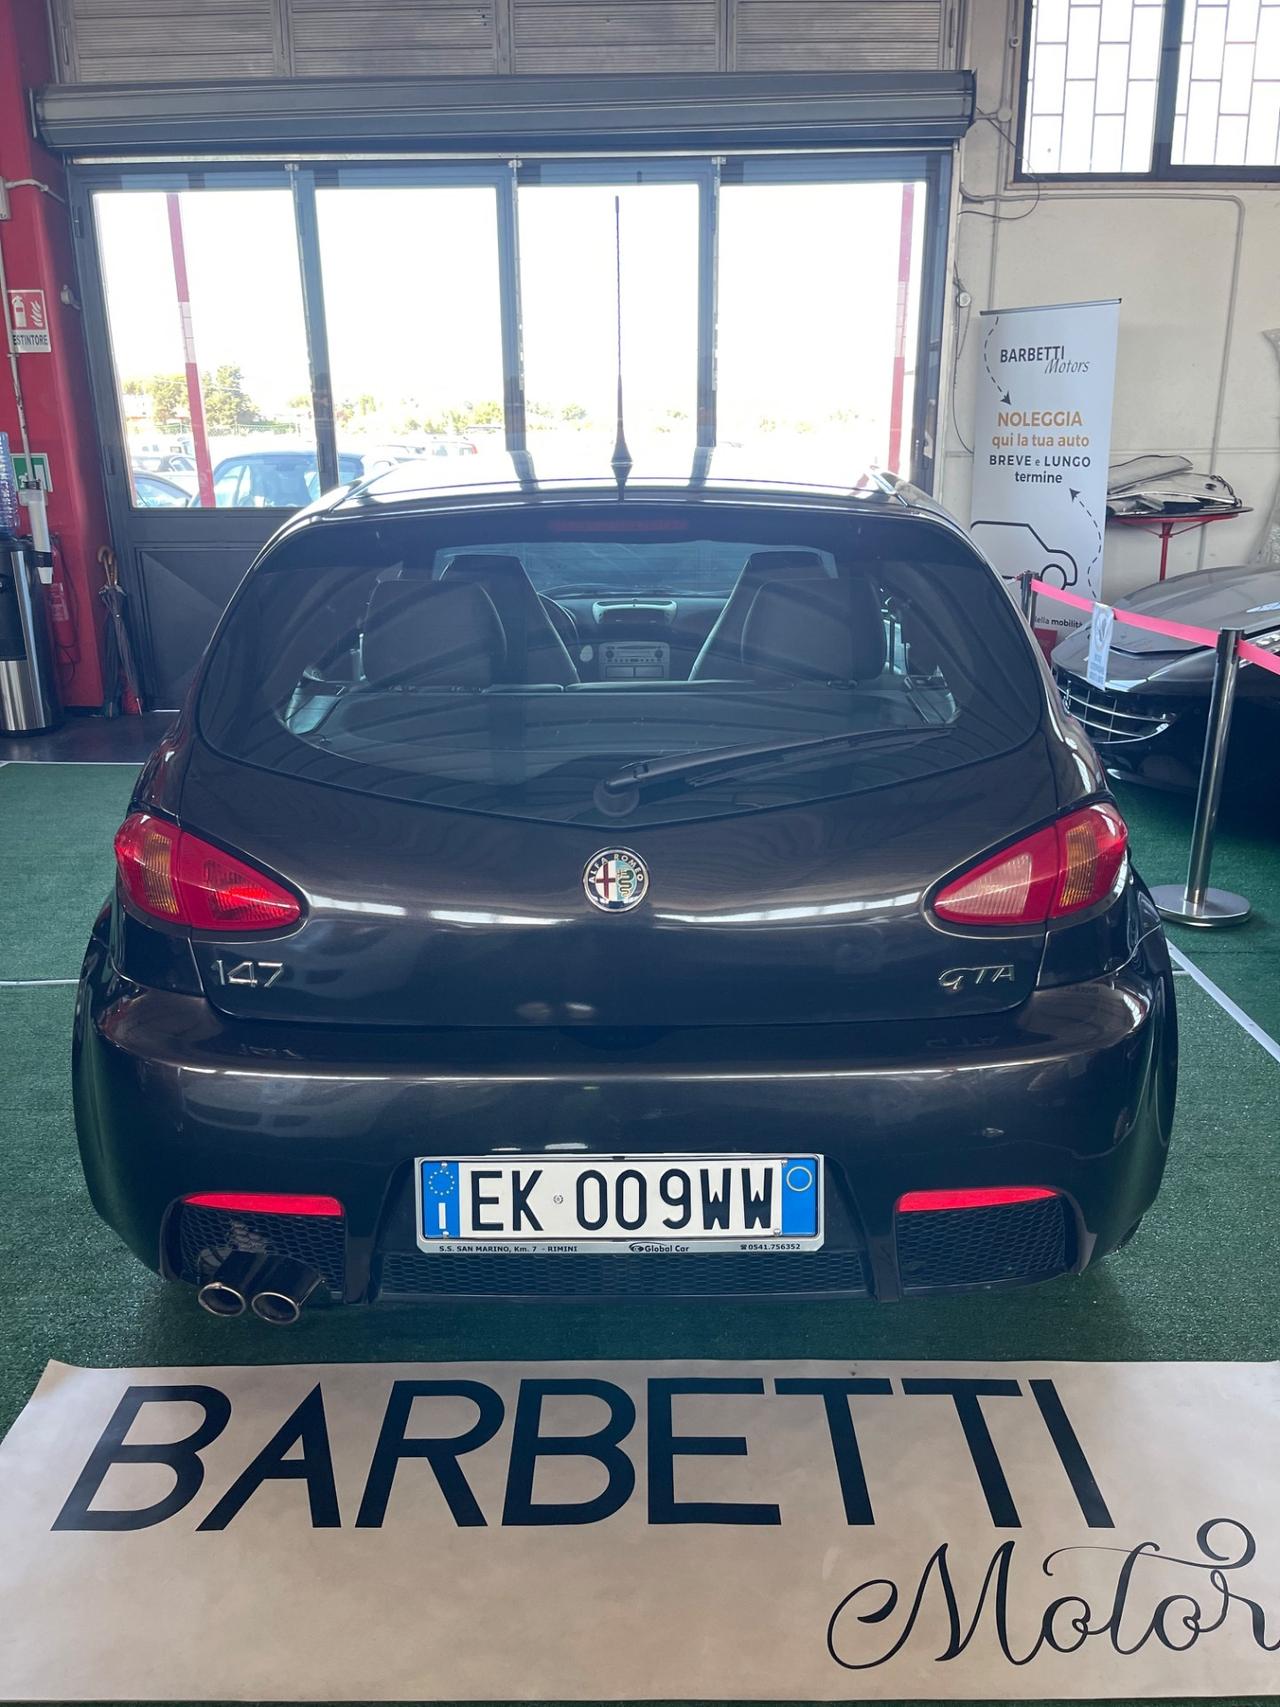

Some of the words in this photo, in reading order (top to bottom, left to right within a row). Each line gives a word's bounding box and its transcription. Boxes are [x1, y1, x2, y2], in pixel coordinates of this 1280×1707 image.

[12, 334, 49, 346] ESTINTORE
[1000, 345, 1065, 364] BARBETTI
[1045, 358, 1091, 375] Motors
[997, 411, 1083, 427] NOLEGGIA
[991, 433, 1014, 449] qui
[1017, 433, 1029, 447] la
[1032, 434, 1054, 447] tua
[1058, 435, 1090, 447] auto
[989, 455, 1032, 466] BREVE
[1034, 458, 1041, 466] e
[1044, 456, 1091, 468] LUNGO
[1015, 471, 1063, 484] termine
[588, 857, 608, 884] ALFA
[613, 853, 644, 882] ROMEO
[211, 959, 284, 988] 147
[938, 965, 1015, 990] GTA
[471, 1169, 544, 1231] EK
[576, 1167, 773, 1231] 009WW
[439, 1245, 454, 1253] S.S.
[457, 1245, 473, 1253] SAN
[476, 1245, 512, 1254] MARINO,
[514, 1245, 530, 1253] Km.
[532, 1245, 537, 1253] 7
[548, 1245, 577, 1253] RIMINI
[644, 1243, 673, 1253] Global
[675, 1244, 690, 1253] Car
[748, 1243, 801, 1251] 0541.756352
[51, 1377, 1115, 1531] BARBETTI
